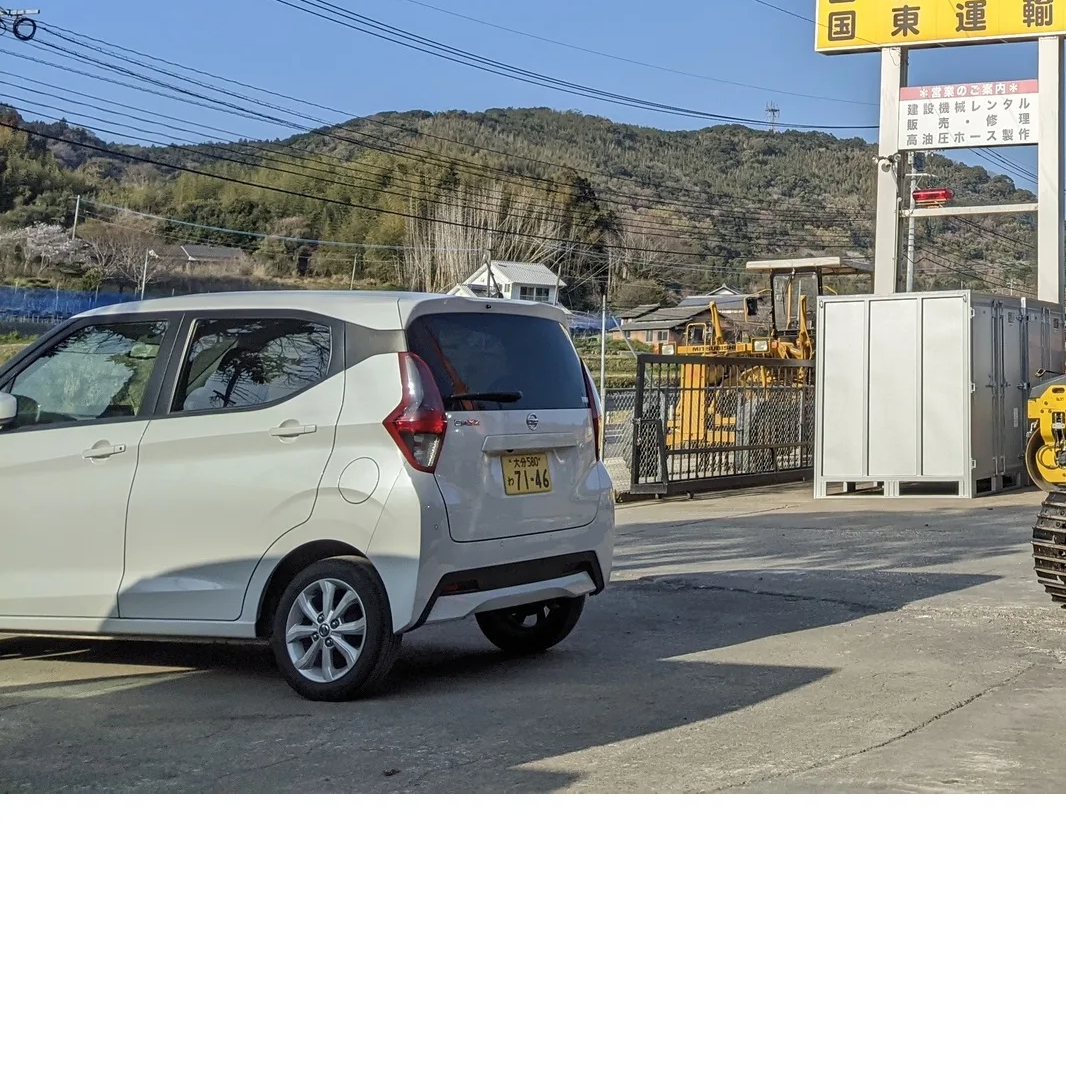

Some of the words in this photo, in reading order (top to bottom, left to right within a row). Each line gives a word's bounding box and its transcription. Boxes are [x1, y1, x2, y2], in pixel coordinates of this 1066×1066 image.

[907, 97, 1031, 116] 建設機械レンタル
[906, 127, 1030, 146] 高油圧ホース製作
